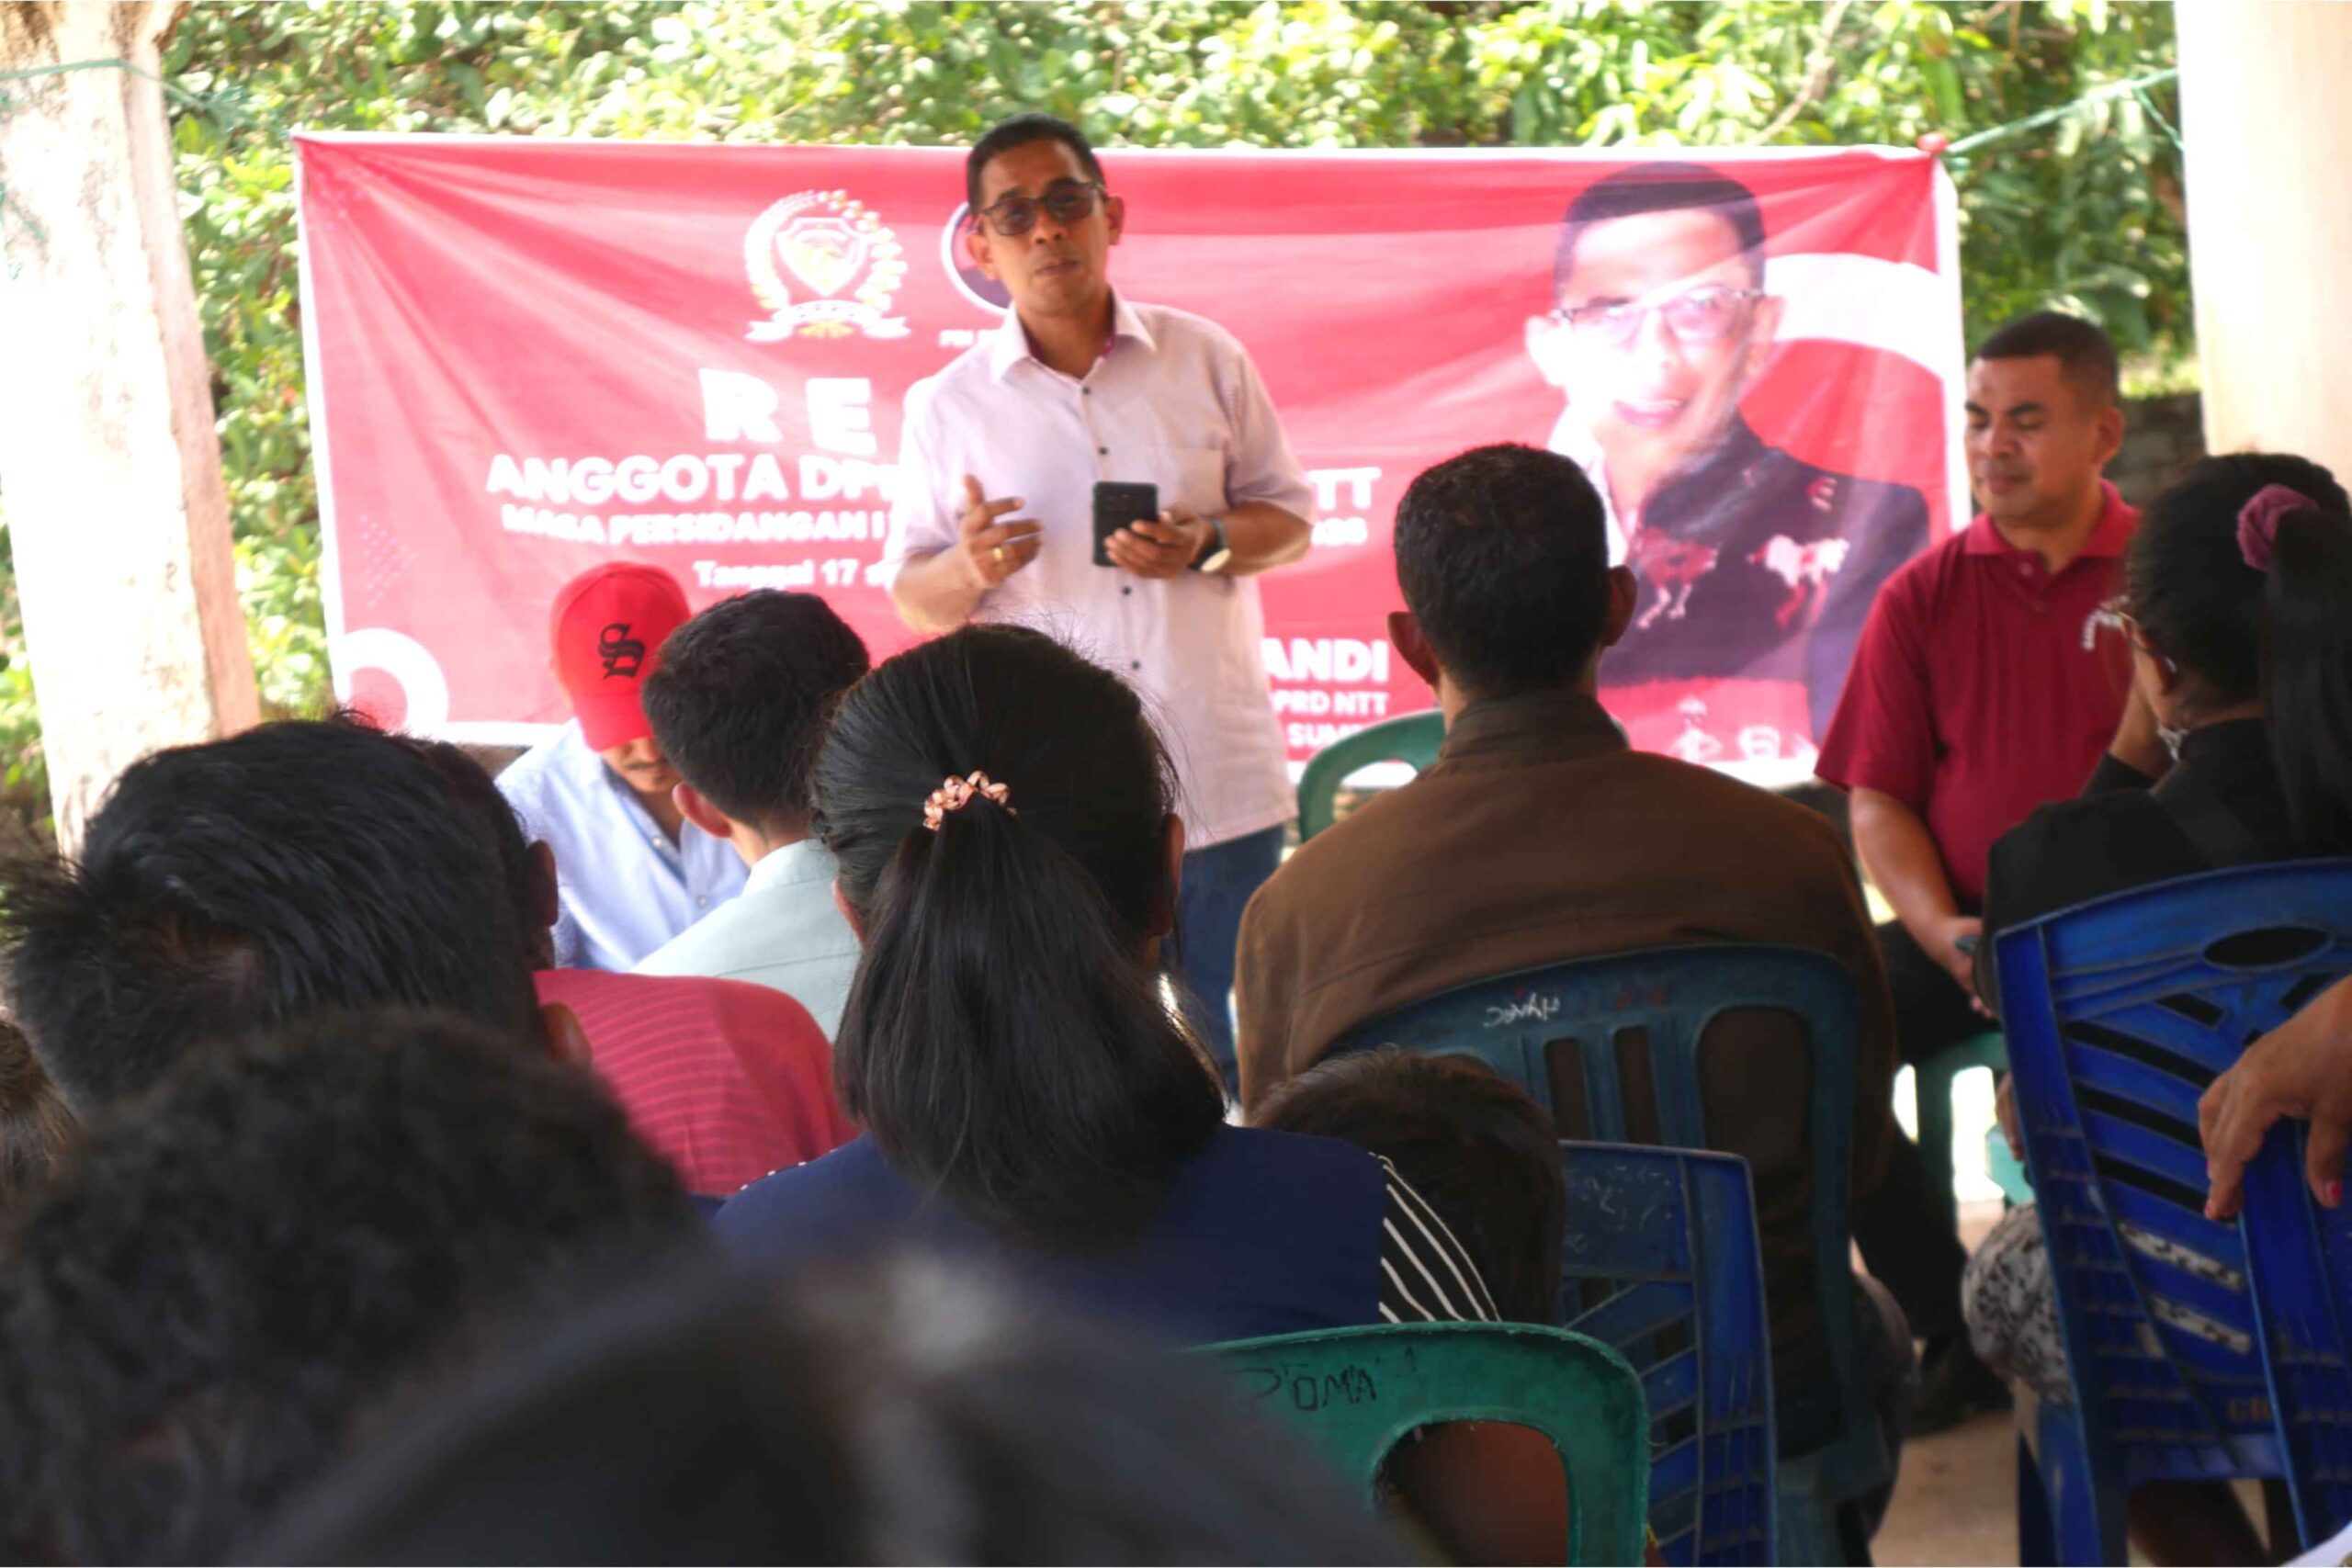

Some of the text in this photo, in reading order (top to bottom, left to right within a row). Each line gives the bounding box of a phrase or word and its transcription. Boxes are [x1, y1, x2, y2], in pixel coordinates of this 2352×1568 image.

[486, 453, 789, 504] ANGGOTA
[608, 510, 868, 545] PERSIDANGAN
[820, 558, 860, 587] 17
[1260, 637, 1388, 682] ANDI
[1271, 690, 1387, 715] PRD NTT
[1288, 723, 1362, 747] SUM
